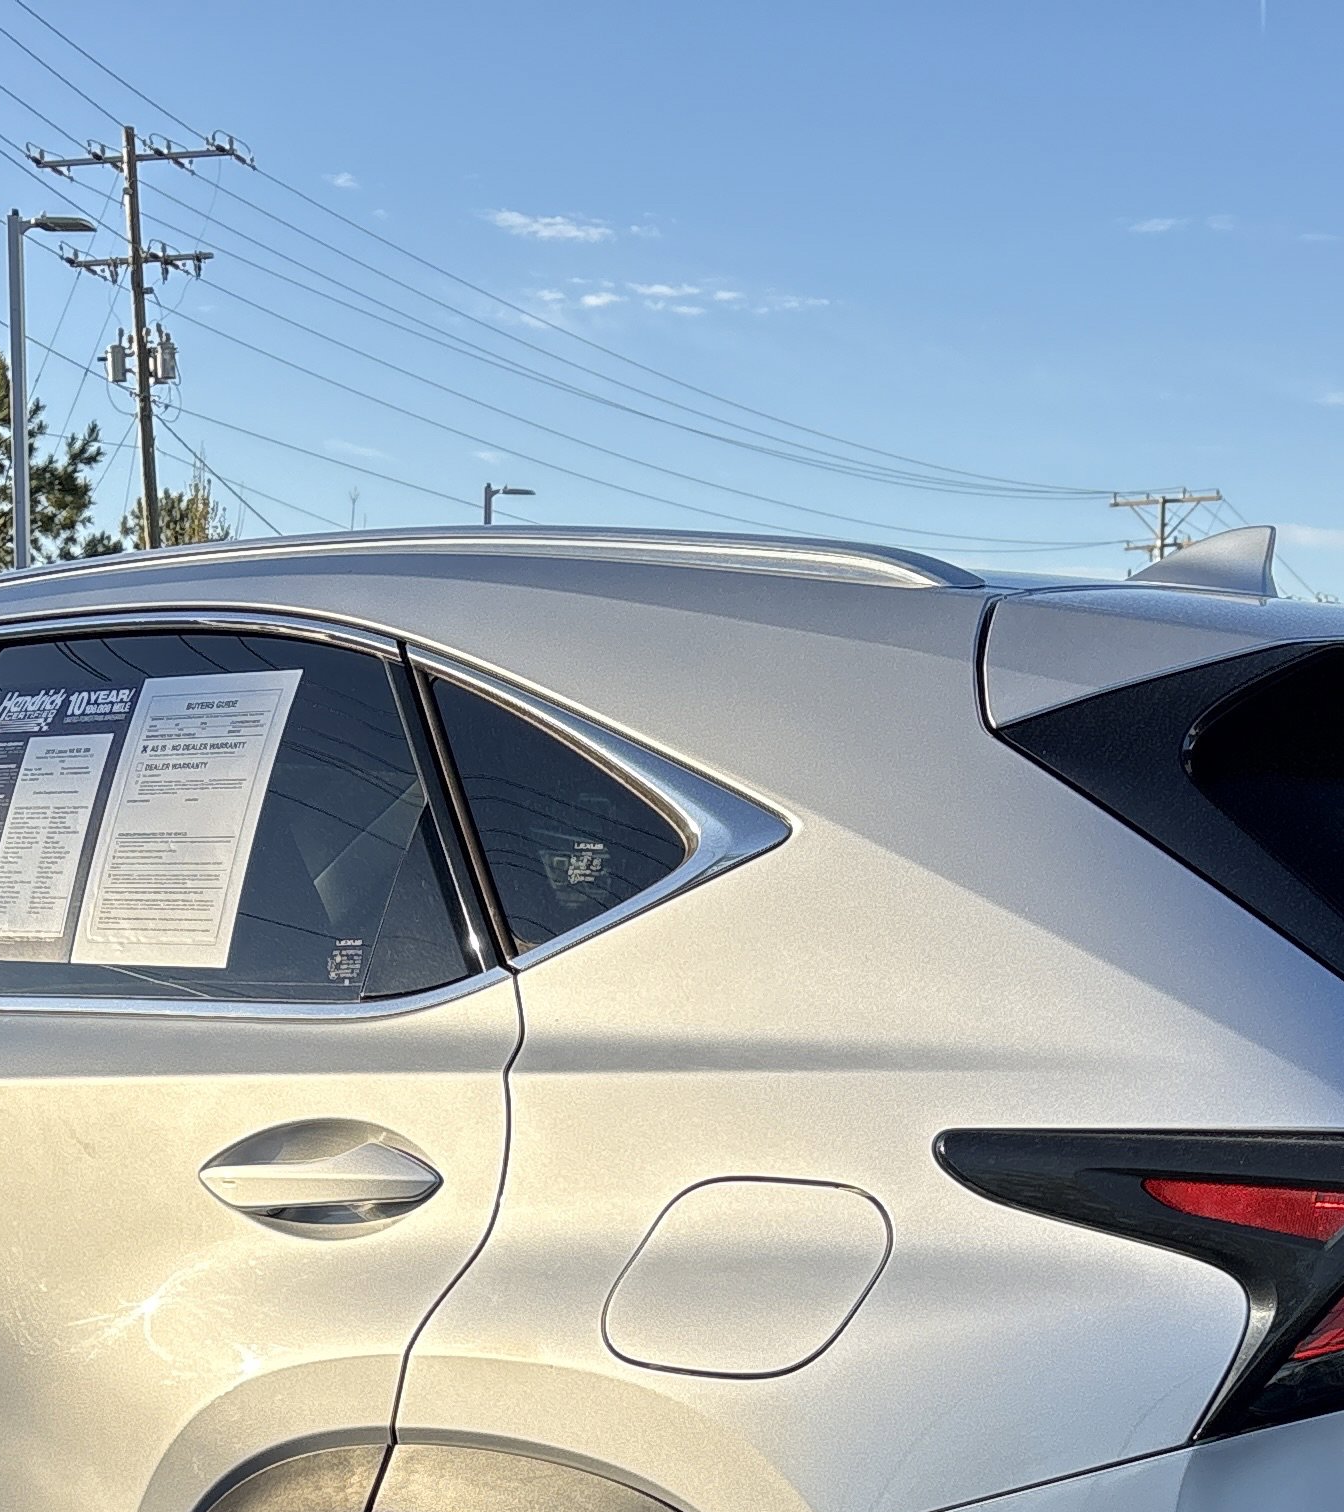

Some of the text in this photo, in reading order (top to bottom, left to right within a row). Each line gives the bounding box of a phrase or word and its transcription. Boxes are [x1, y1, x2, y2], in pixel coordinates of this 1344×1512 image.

[67, 688, 136, 715] 10 YEAR/
[216, 700, 239, 709] GUIDE
[574, 842, 604, 850] LEXUS
